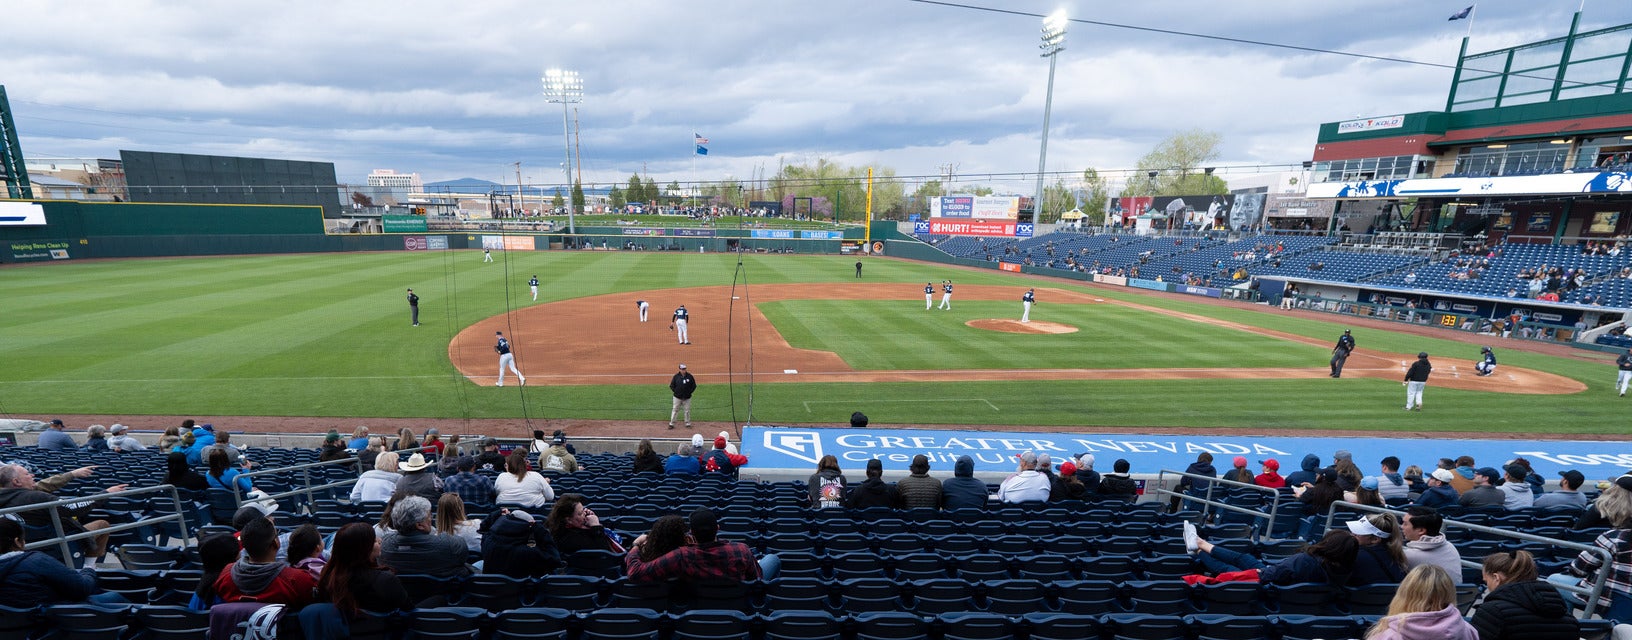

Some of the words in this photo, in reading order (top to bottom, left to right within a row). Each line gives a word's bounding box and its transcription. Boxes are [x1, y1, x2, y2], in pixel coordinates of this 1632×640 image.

[942, 223, 970, 232] HURT!
[836, 434, 1068, 452] GREATER
[1072, 438, 1292, 456] NEVADA
[842, 450, 961, 463] Credit
[975, 452, 1077, 465] Uno
